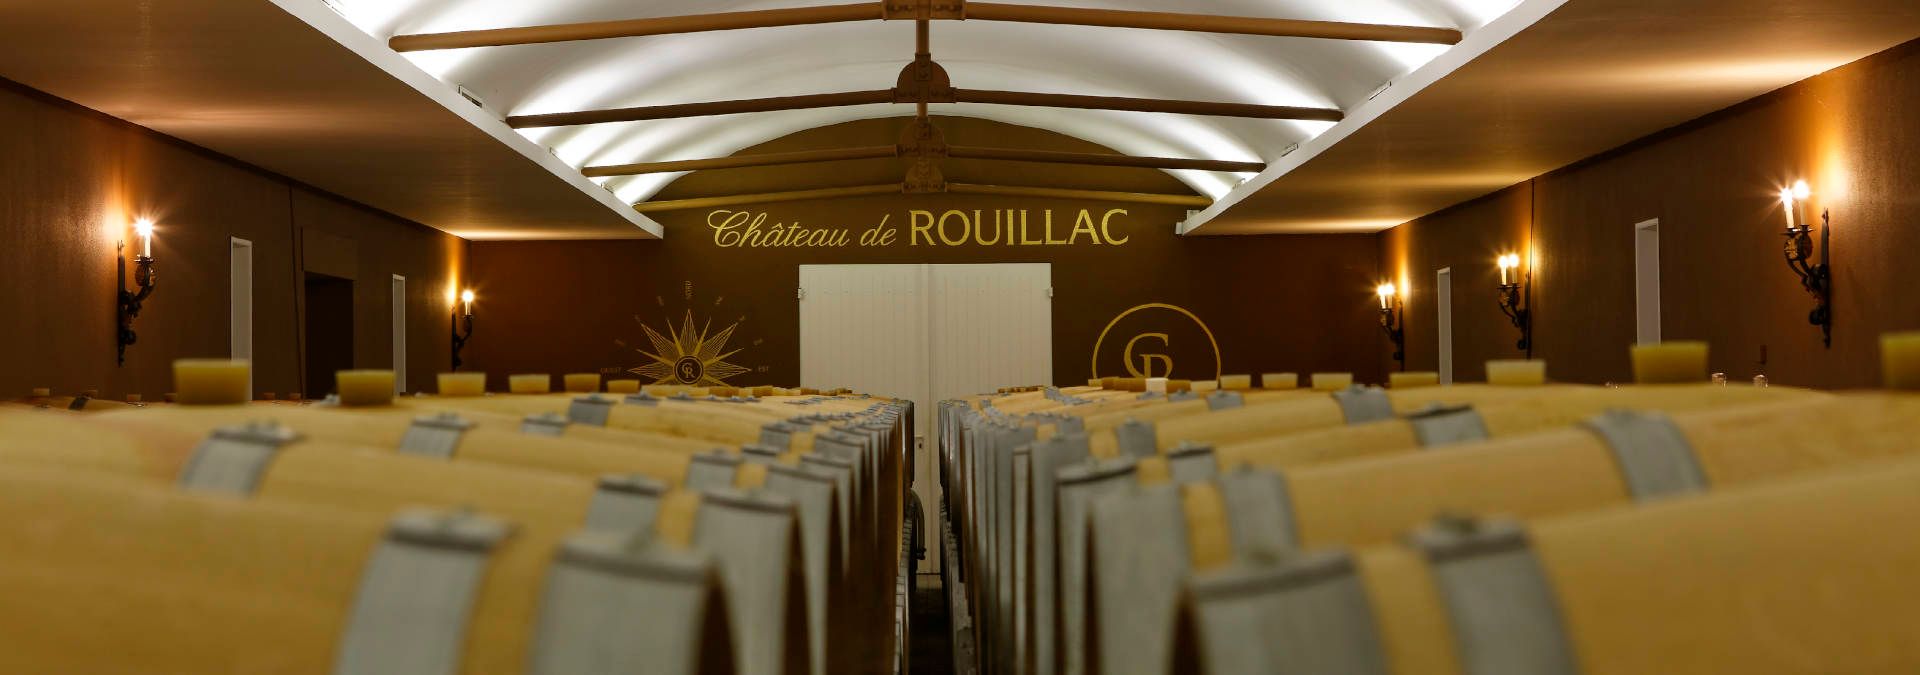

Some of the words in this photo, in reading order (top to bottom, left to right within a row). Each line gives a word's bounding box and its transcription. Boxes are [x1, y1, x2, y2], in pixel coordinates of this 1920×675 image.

[707, 209, 850, 248] Château
[859, 213, 897, 247] de
[909, 208, 1129, 246] ROUILLAC
